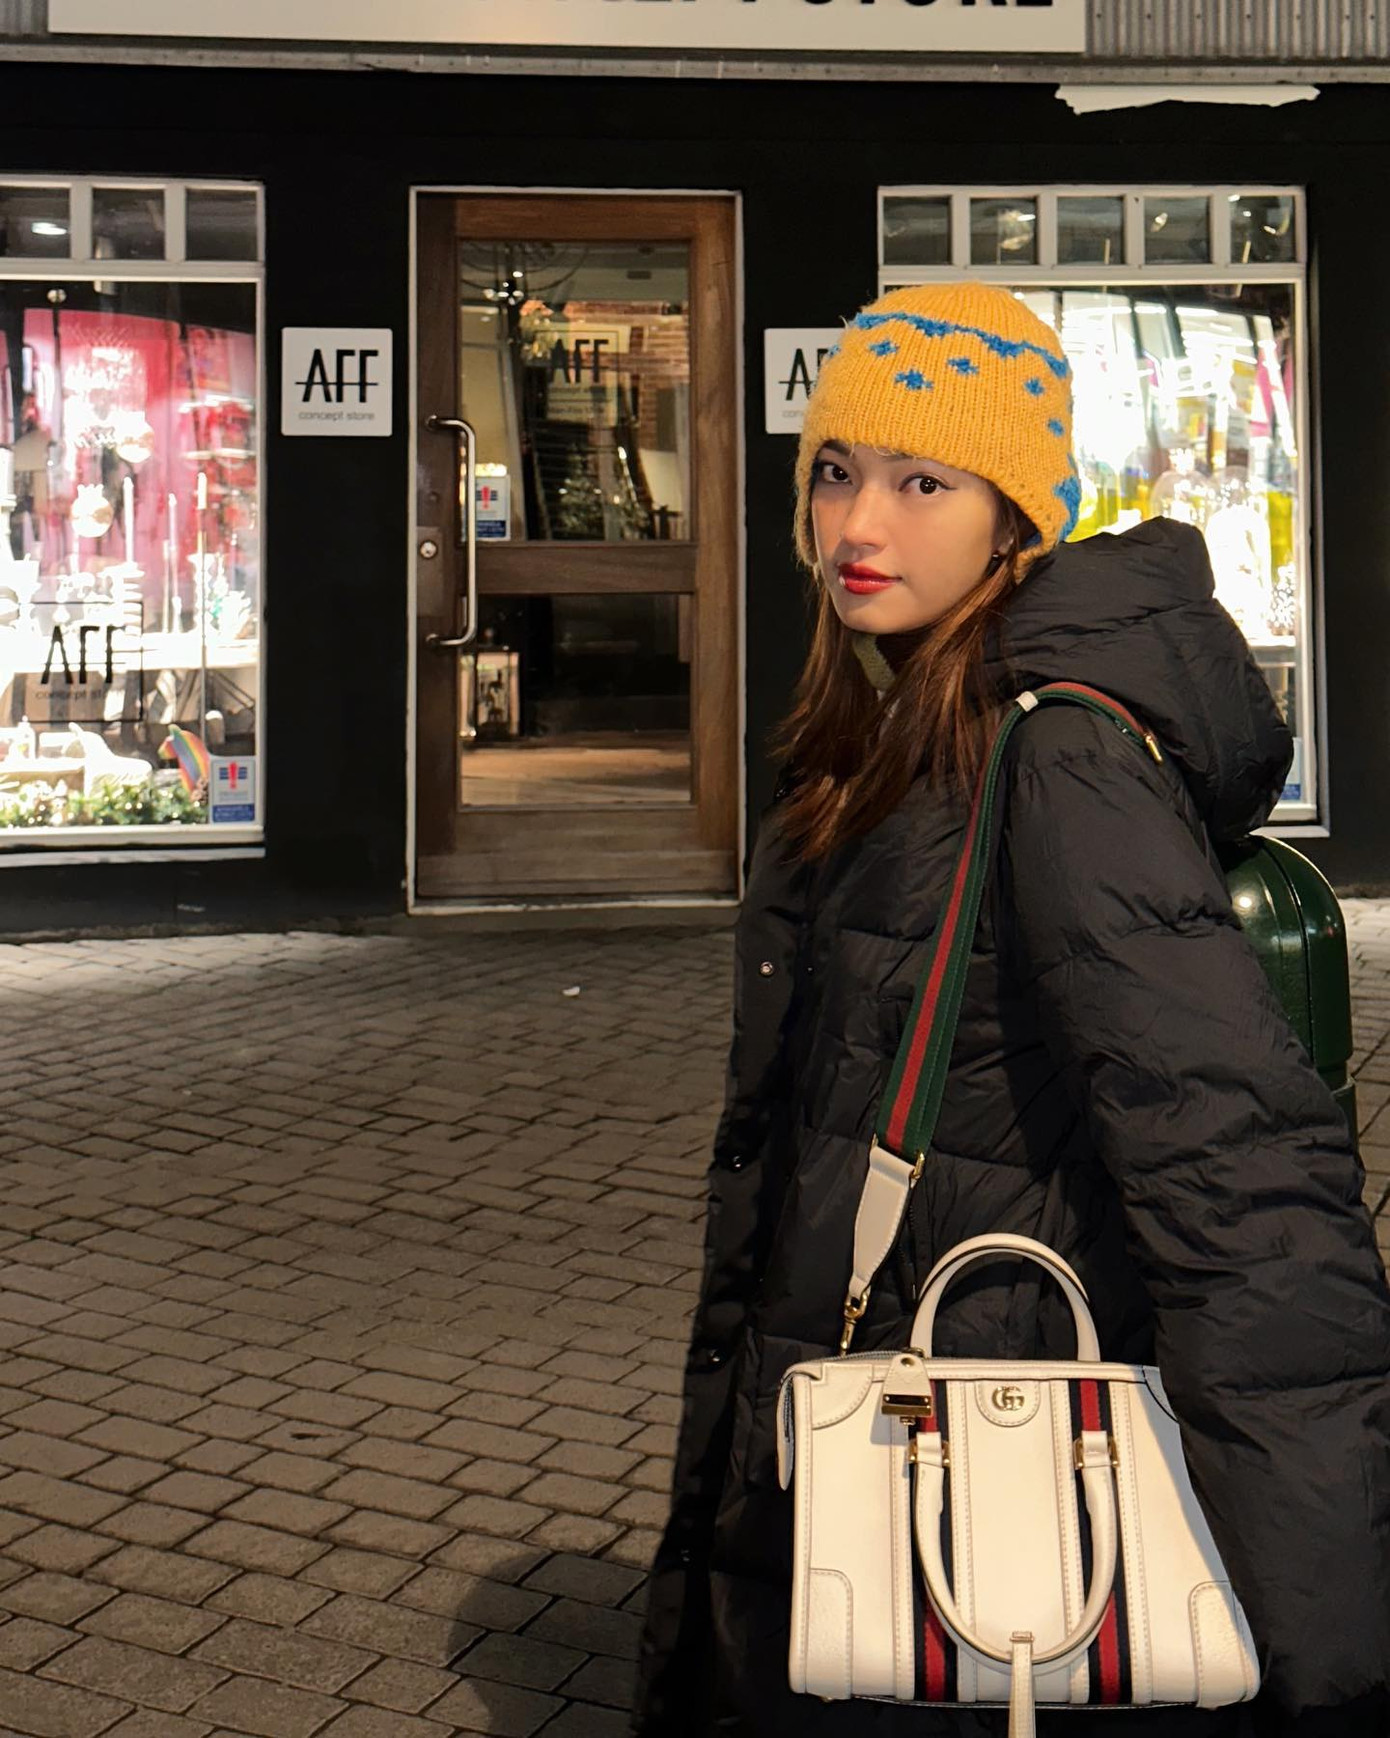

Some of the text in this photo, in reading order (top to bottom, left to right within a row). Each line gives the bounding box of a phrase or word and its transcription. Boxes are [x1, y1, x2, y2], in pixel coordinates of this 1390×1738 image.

[295, 348, 379, 403] AFF
[549, 339, 609, 383] AFF
[298, 410, 376, 421] concept store
[40, 625, 126, 684] AFF
